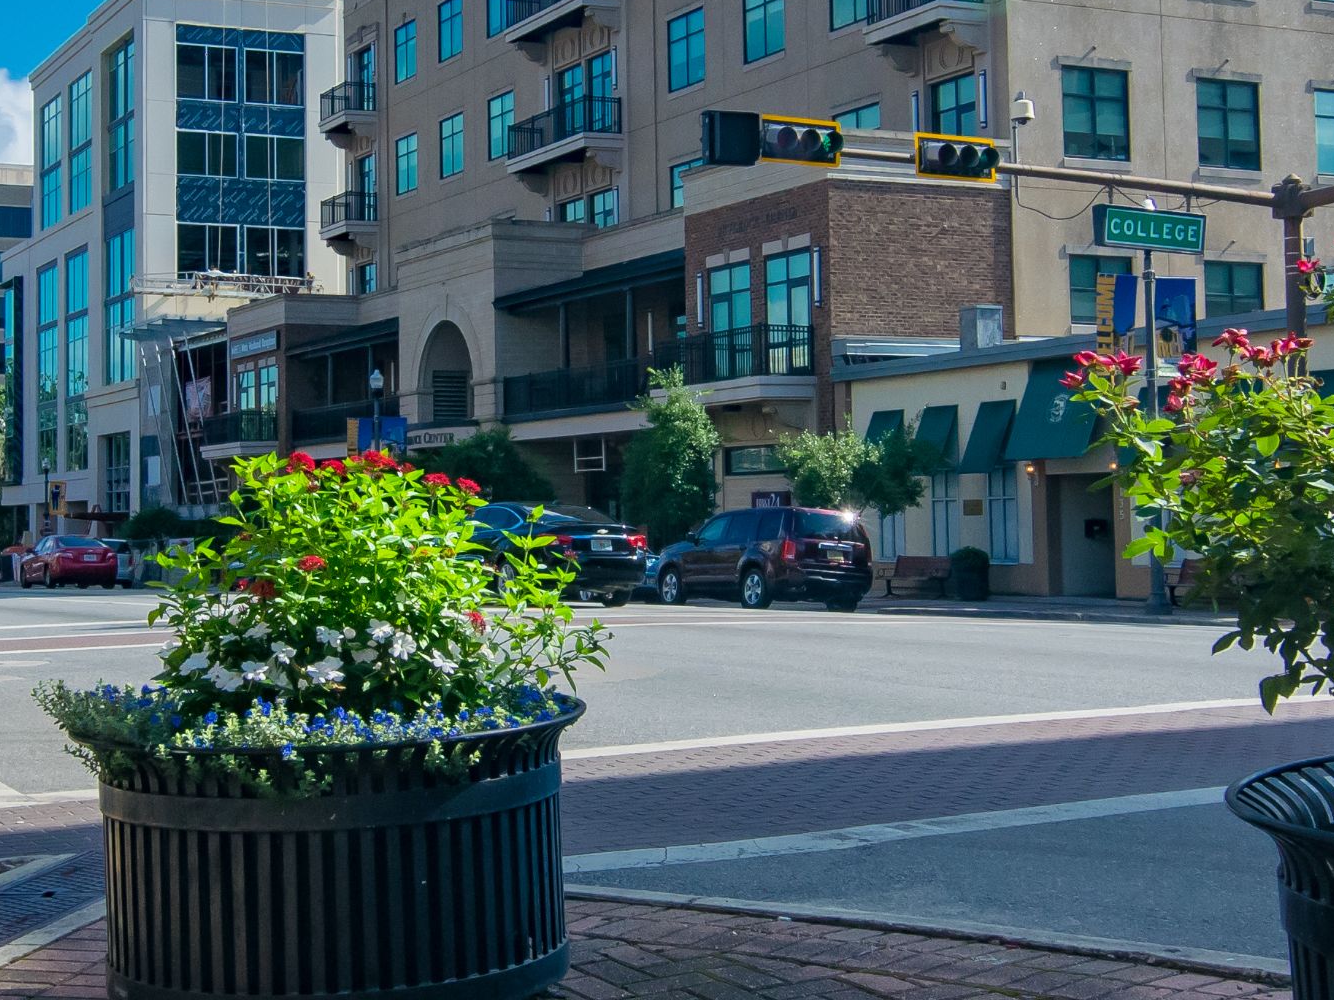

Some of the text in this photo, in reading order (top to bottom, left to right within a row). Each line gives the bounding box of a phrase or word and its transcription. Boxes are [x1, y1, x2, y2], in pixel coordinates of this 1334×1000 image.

[1110, 218, 1198, 242] COLLEGE
[1097, 273, 1116, 355] ELCOME
[424, 432, 454, 443] CENTER
